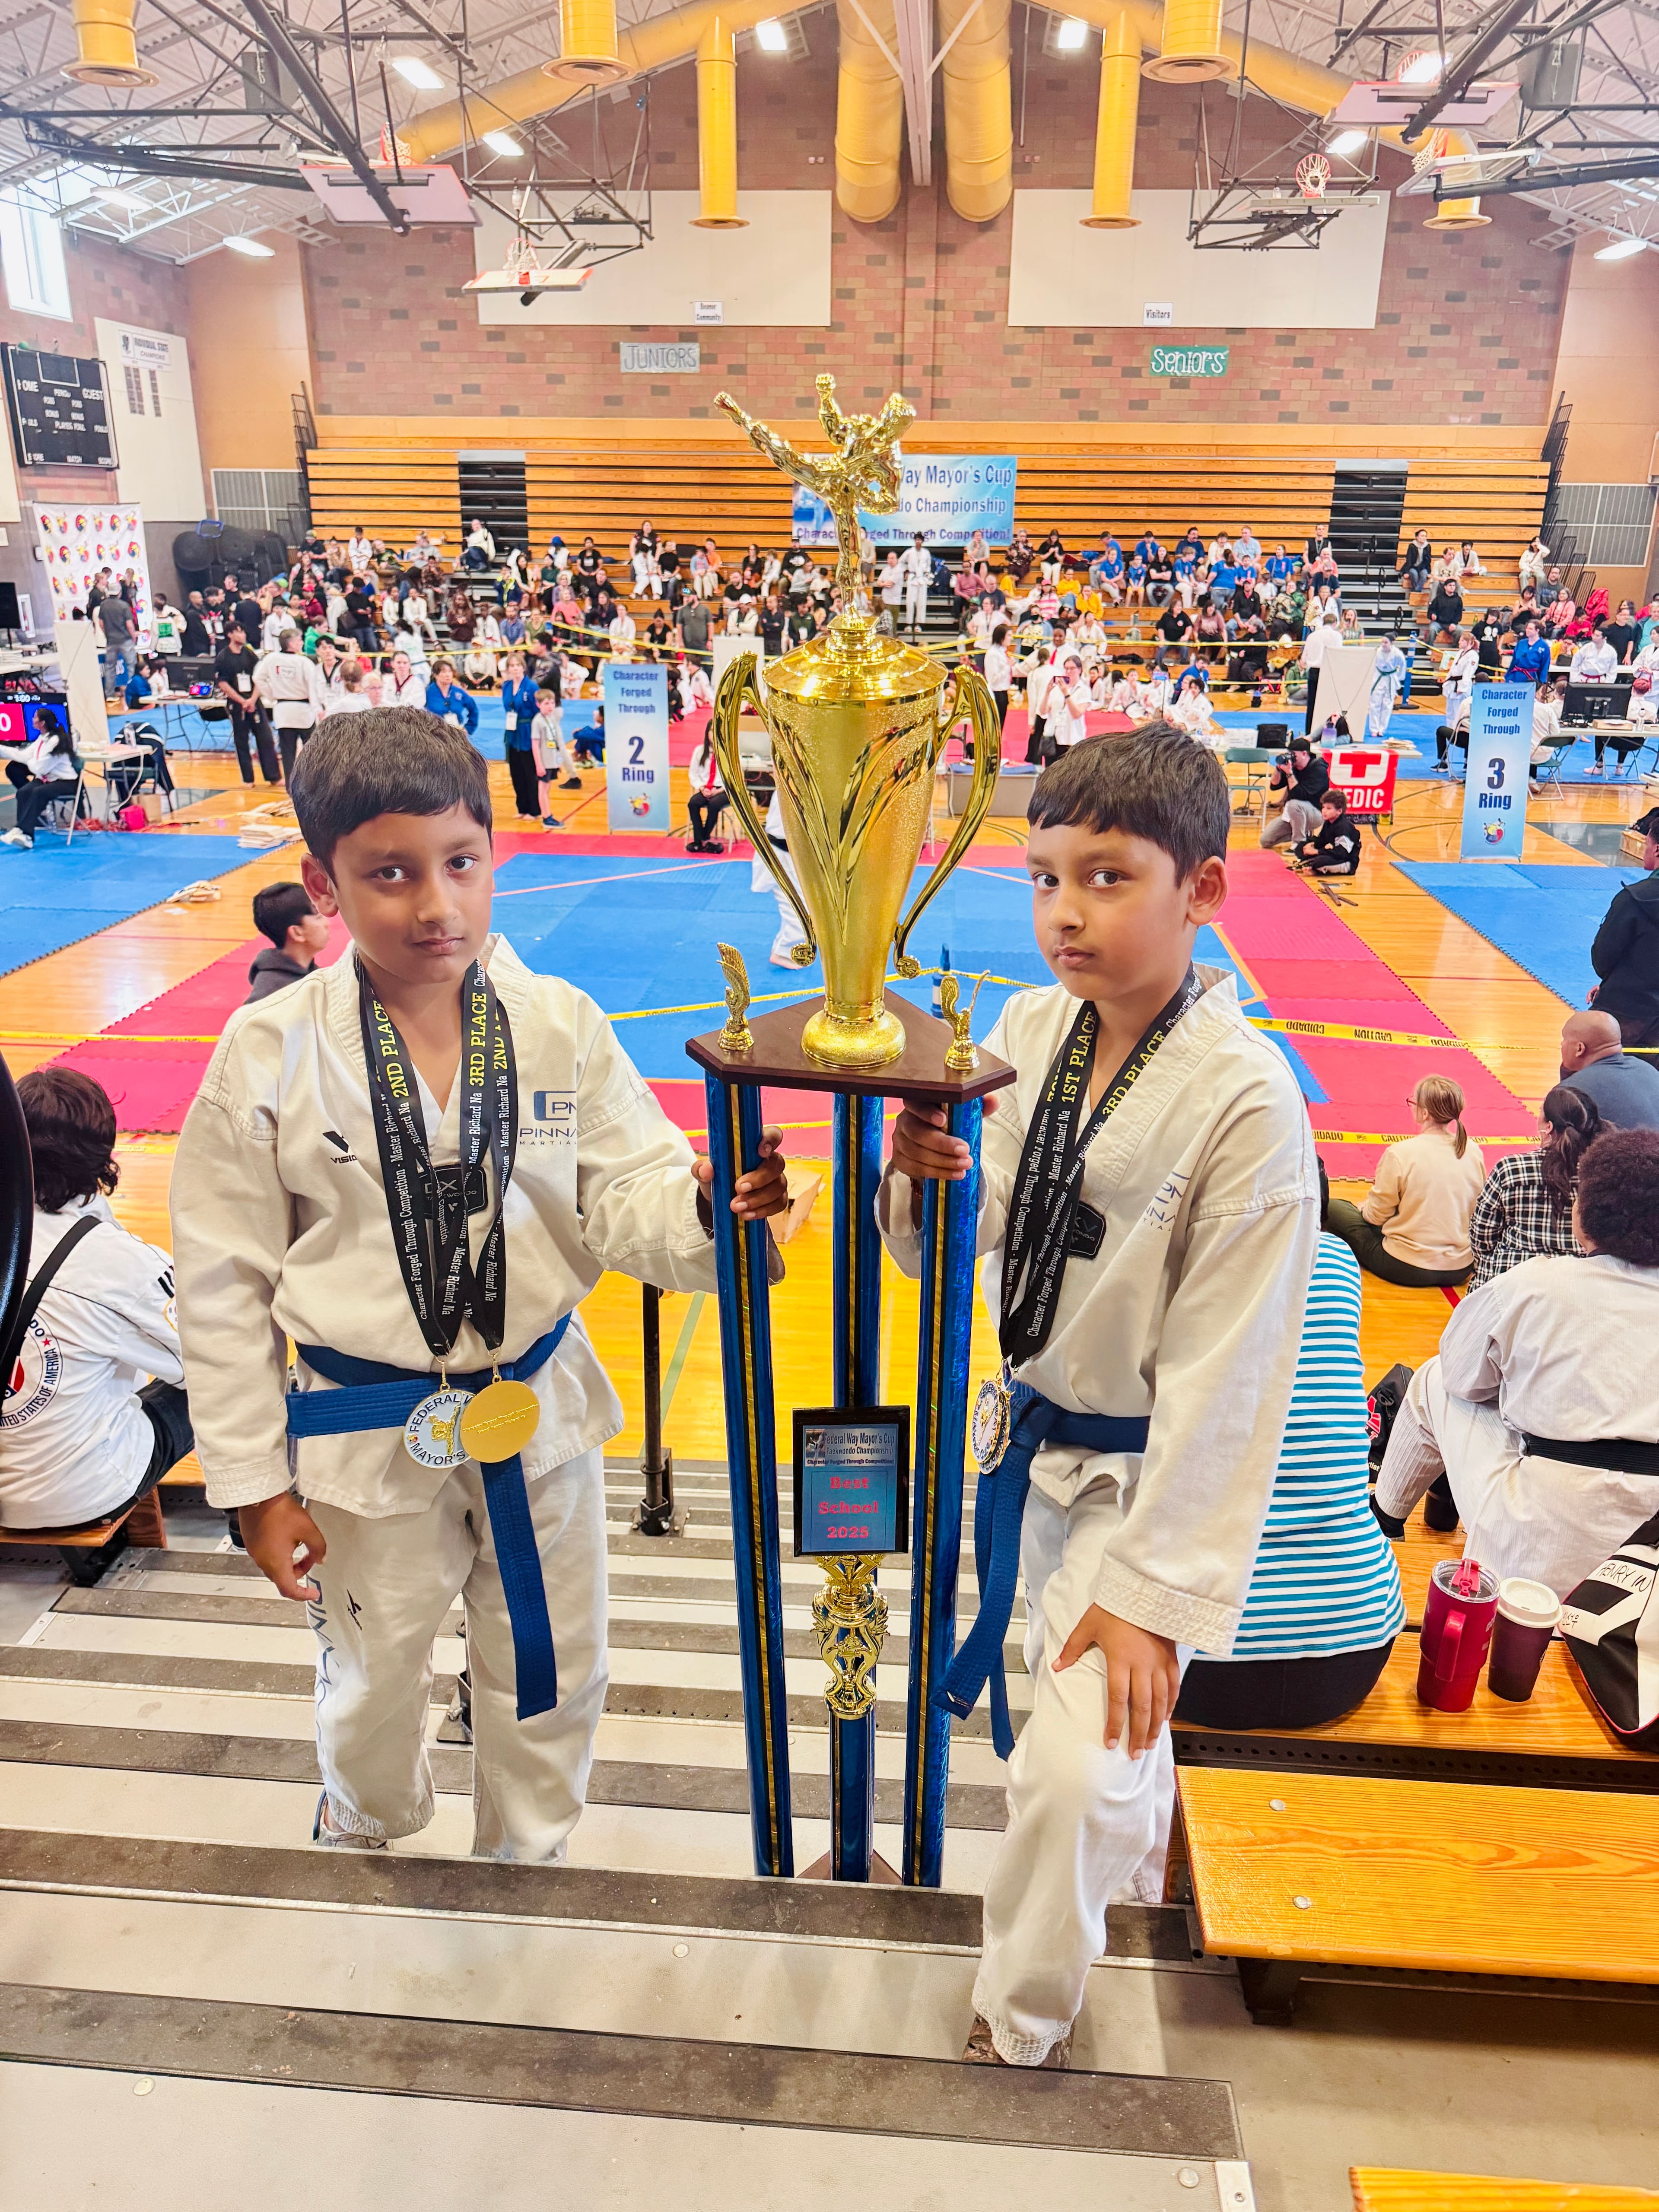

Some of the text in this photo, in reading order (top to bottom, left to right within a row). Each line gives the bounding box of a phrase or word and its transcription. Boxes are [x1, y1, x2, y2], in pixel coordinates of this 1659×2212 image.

[1146, 309, 1170, 318] Visitors
[623, 346, 696, 369] JUNIORS
[901, 465, 1011, 488] ay Mayor's Cup
[916, 497, 1007, 515] Championship
[797, 528, 837, 541] Charac
[893, 528, 935, 541] Throgh
[940, 528, 1010, 541] Compition!
[613, 671, 659, 681] Character
[621, 687, 652, 698] Forged
[1481, 690, 1527, 700] Character
[618, 704, 656, 713] Through
[1487, 707, 1518, 717] Forged
[1483, 724, 1520, 734] Through
[629, 736, 644, 765] 2
[622, 767, 654, 783] Ring
[1487, 758, 1505, 789] 3
[1344, 788, 1384, 809] EDIC
[1478, 793, 1512, 810] Ring
[373, 1000, 399, 1057] PLACE
[471, 992, 487, 1047] PLACE
[1286, 1021, 1325, 1034] CUIDADO
[1069, 1011, 1096, 1068] PLACE
[1354, 1029, 1392, 1042] CAUTION
[387, 1063, 410, 1099] 2ND
[469, 1053, 485, 1087] 3RD
[496, 1075, 508, 1087] Na
[470, 1093, 482, 1103] Na
[1062, 1072, 1080, 1103] 1ST
[398, 1102, 410, 1115] Na
[497, 1088, 509, 1119] Richard
[1058, 1110, 1071, 1121] Na
[401, 1116, 422, 1144] Richard
[469, 1106, 481, 1135] Richard
[1037, 1234, 1051, 1262] Through
[1047, 1191, 1068, 1233] Competition
[1065, 1160, 1081, 1186] Master
[1078, 1132, 1096, 1161] Richard
[1093, 1121, 1104, 1133] Na
[1102, 1086, 1128, 1117] 3RD
[1125, 1030, 1165, 1082] PLACE
[1166, 997, 1195, 1029] Character
[501, 1121, 509, 1147] Master
[1052, 1123, 1068, 1153] Richard
[330, 1155, 357, 1163] VISIO
[390, 1135, 403, 1162] Master
[469, 1137, 480, 1164] Master
[501, 1155, 509, 1199] mpetition
[1048, 1154, 1062, 1181] Master
[394, 1169, 413, 1217] Competition
[1020, 1175, 1039, 1204] Through
[401, 1218, 417, 1252] Through
[1011, 1207, 1030, 1250] Competition
[488, 1232, 499, 1260] Master
[407, 1253, 422, 1282] Forged
[450, 1247, 466, 1274] Master
[1007, 1259, 1018, 1283] Master
[486, 1260, 497, 1289] Richard
[415, 1284, 427, 1319] Character
[444, 1275, 460, 1303] Richard
[485, 1290, 497, 1301] Na
[1027, 1303, 1046, 1336] Character
[1037, 1277, 1053, 1303] Forged
[1046, 1247, 1062, 1276] Through
[442, 1305, 454, 1315] Na
[44, 1348, 59, 1385] AMERICA
[39, 1386, 53, 1397] OF
[18, 1395, 47, 1421] STATES
[410, 1394, 461, 1432] FEDERAL
[824, 1433, 895, 1446] Federal Way Mayor's Cup
[856, 1446, 893, 1455] Championship
[410, 1443, 465, 1465] MAYOR'S
[830, 1476, 869, 1489] Best
[818, 1501, 879, 1514] School
[827, 1526, 869, 1539] 2025
[1596, 1564, 1636, 1583] HENRY
